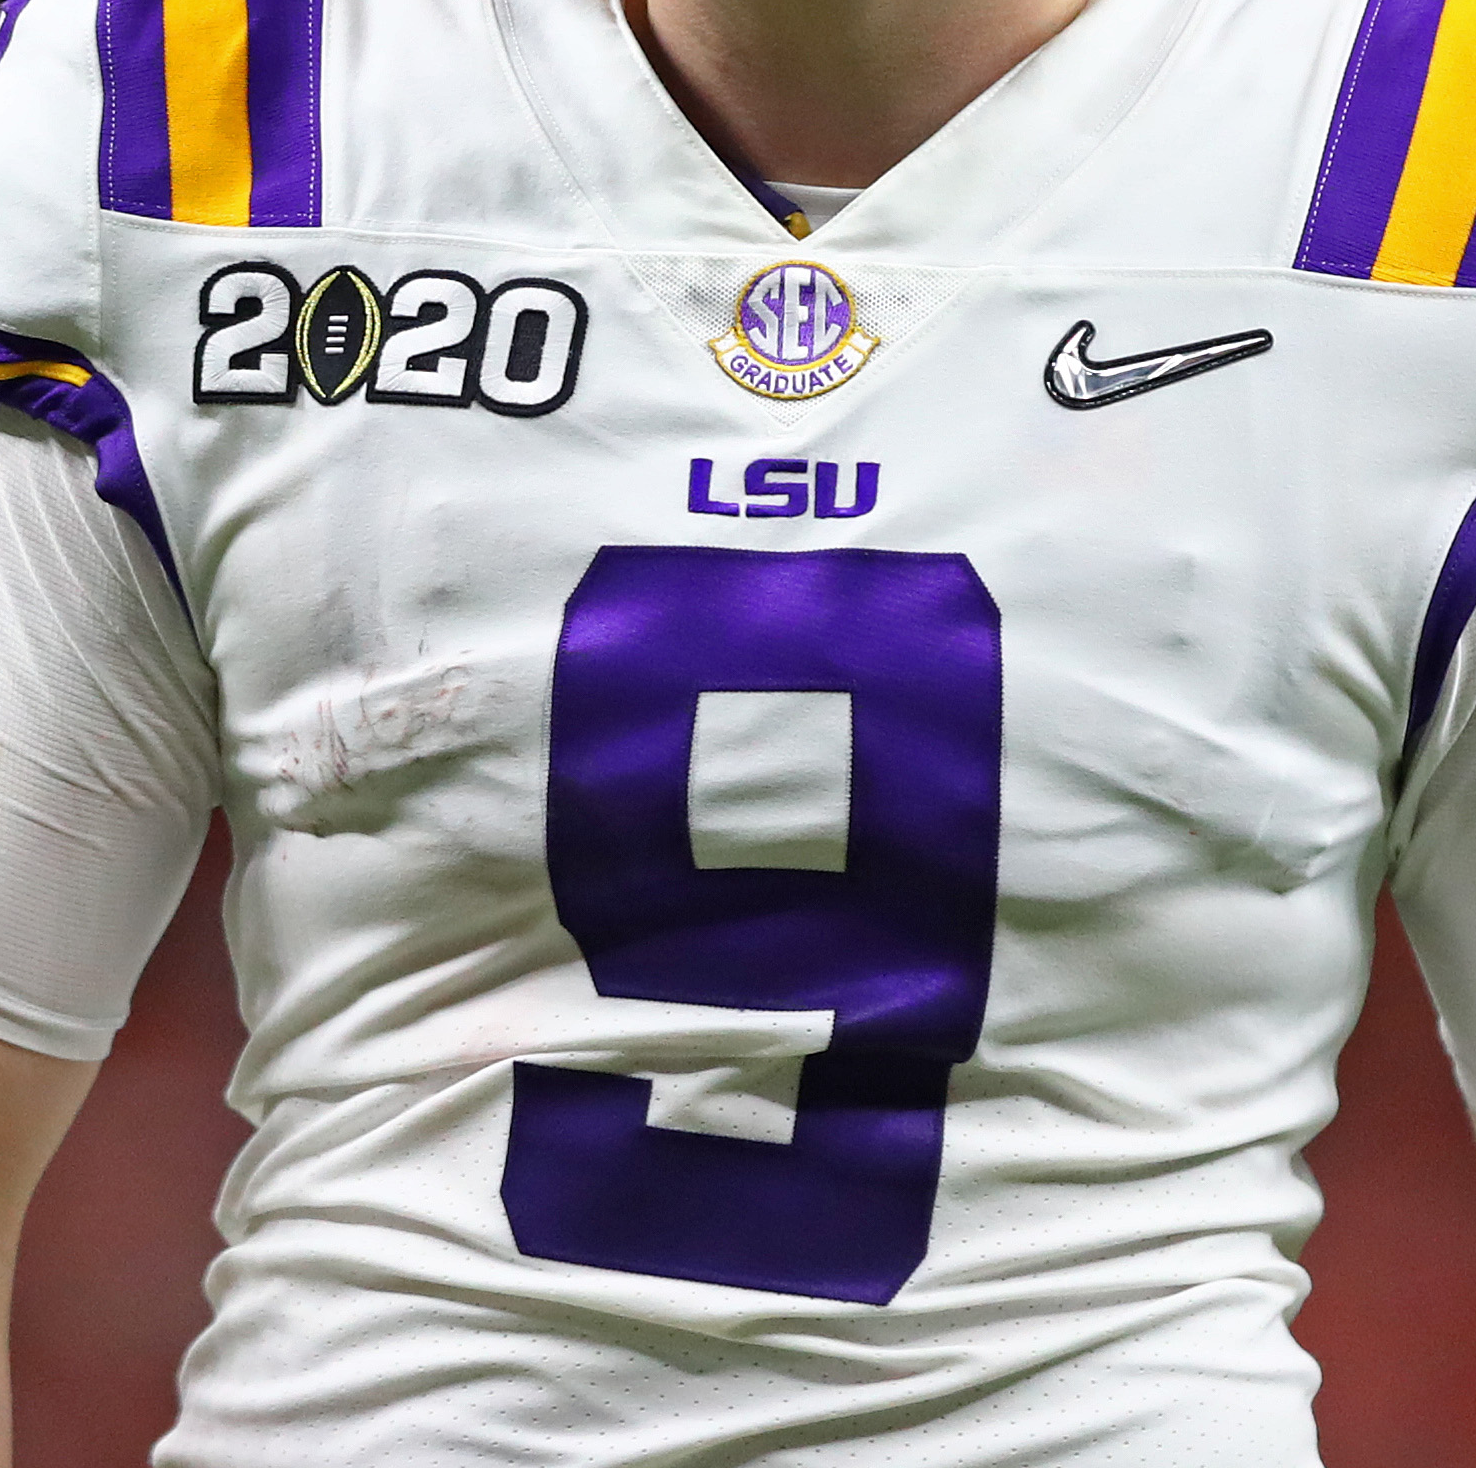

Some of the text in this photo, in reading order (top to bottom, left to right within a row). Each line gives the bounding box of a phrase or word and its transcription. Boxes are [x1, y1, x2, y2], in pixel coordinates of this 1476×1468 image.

[746, 266, 844, 361] SEC
[729, 353, 854, 394] GRADUATE
[688, 457, 881, 520] LSU
[500, 545, 1003, 1306] 9
